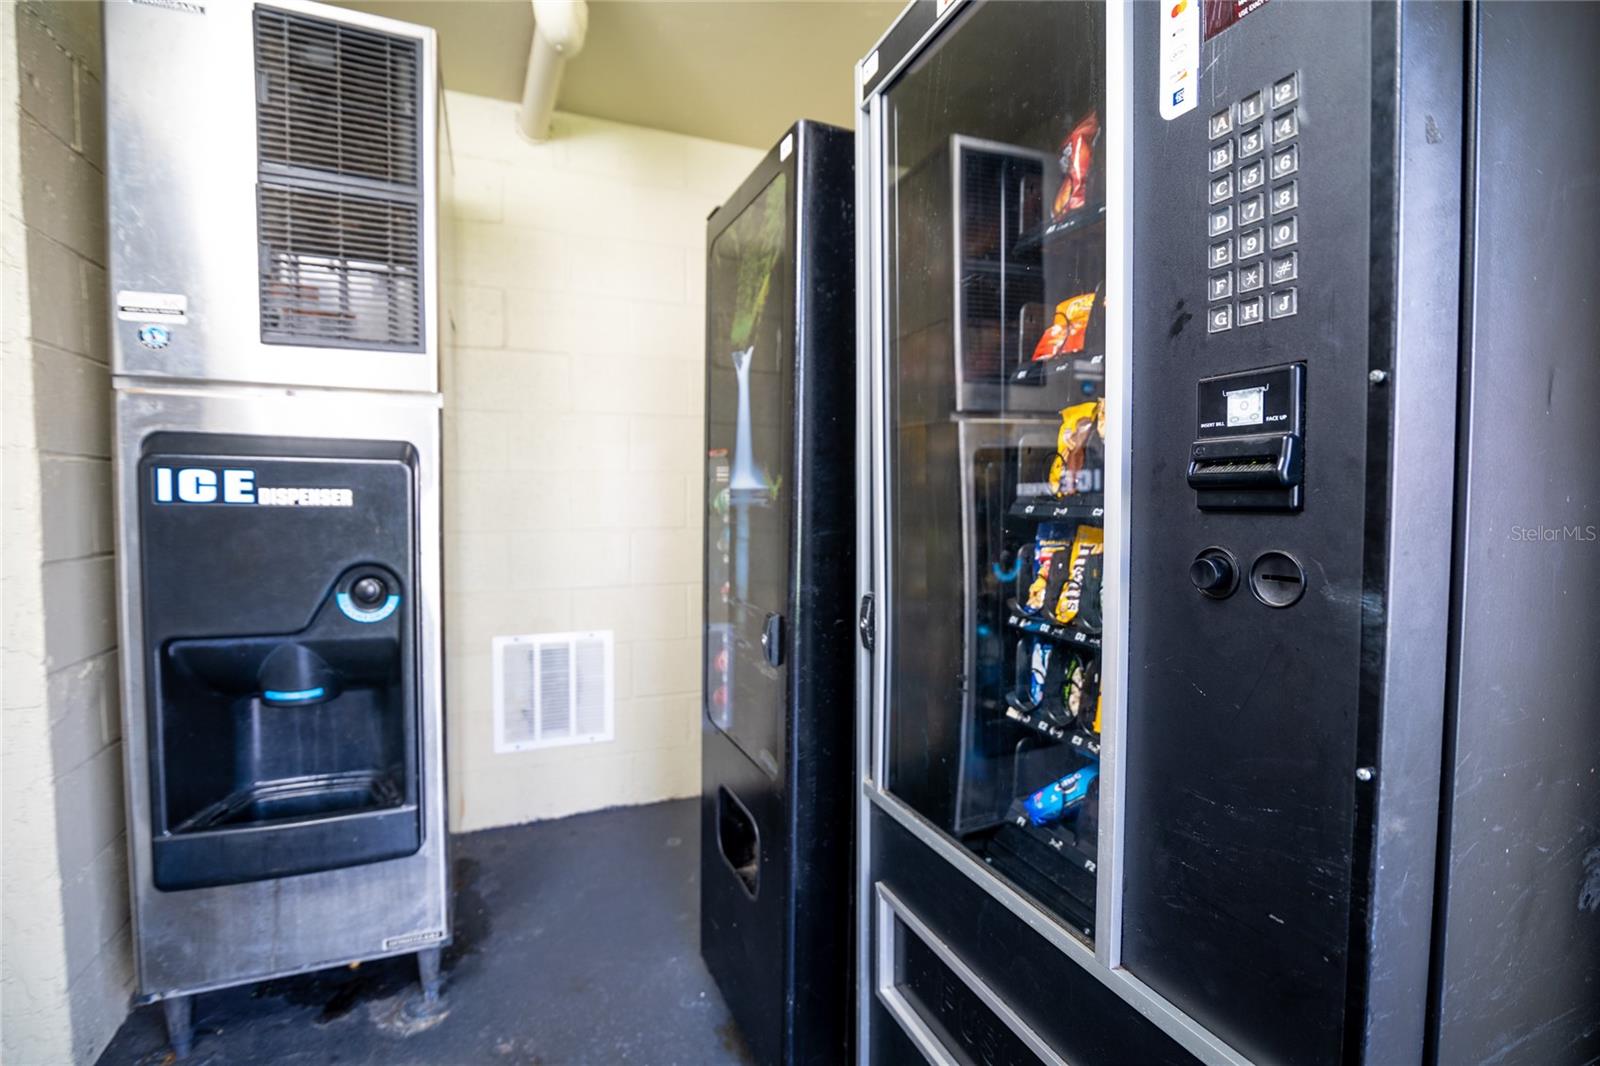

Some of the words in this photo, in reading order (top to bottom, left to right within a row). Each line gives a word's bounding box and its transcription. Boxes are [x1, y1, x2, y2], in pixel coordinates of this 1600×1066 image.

[1279, 83, 1291, 101] 2
[1247, 101, 1256, 117] 1
[1215, 117, 1228, 133] A
[1281, 119, 1291, 134] 4
[1216, 149, 1228, 166] B
[1280, 154, 1291, 170] 6
[1246, 167, 1257, 184] 5
[1215, 181, 1228, 196] C
[1280, 190, 1291, 206] 8
[1247, 202, 1257, 218] 7
[1215, 215, 1228, 231] D
[1279, 225, 1290, 240] 0
[1246, 237, 1257, 251] 9
[1215, 246, 1228, 261] E
[1215, 279, 1227, 295] F
[1279, 295, 1290, 311] J
[1214, 311, 1227, 325] G
[1244, 303, 1258, 320] H
[156, 467, 255, 504] ICE
[257, 487, 353, 506] DISPENSER
